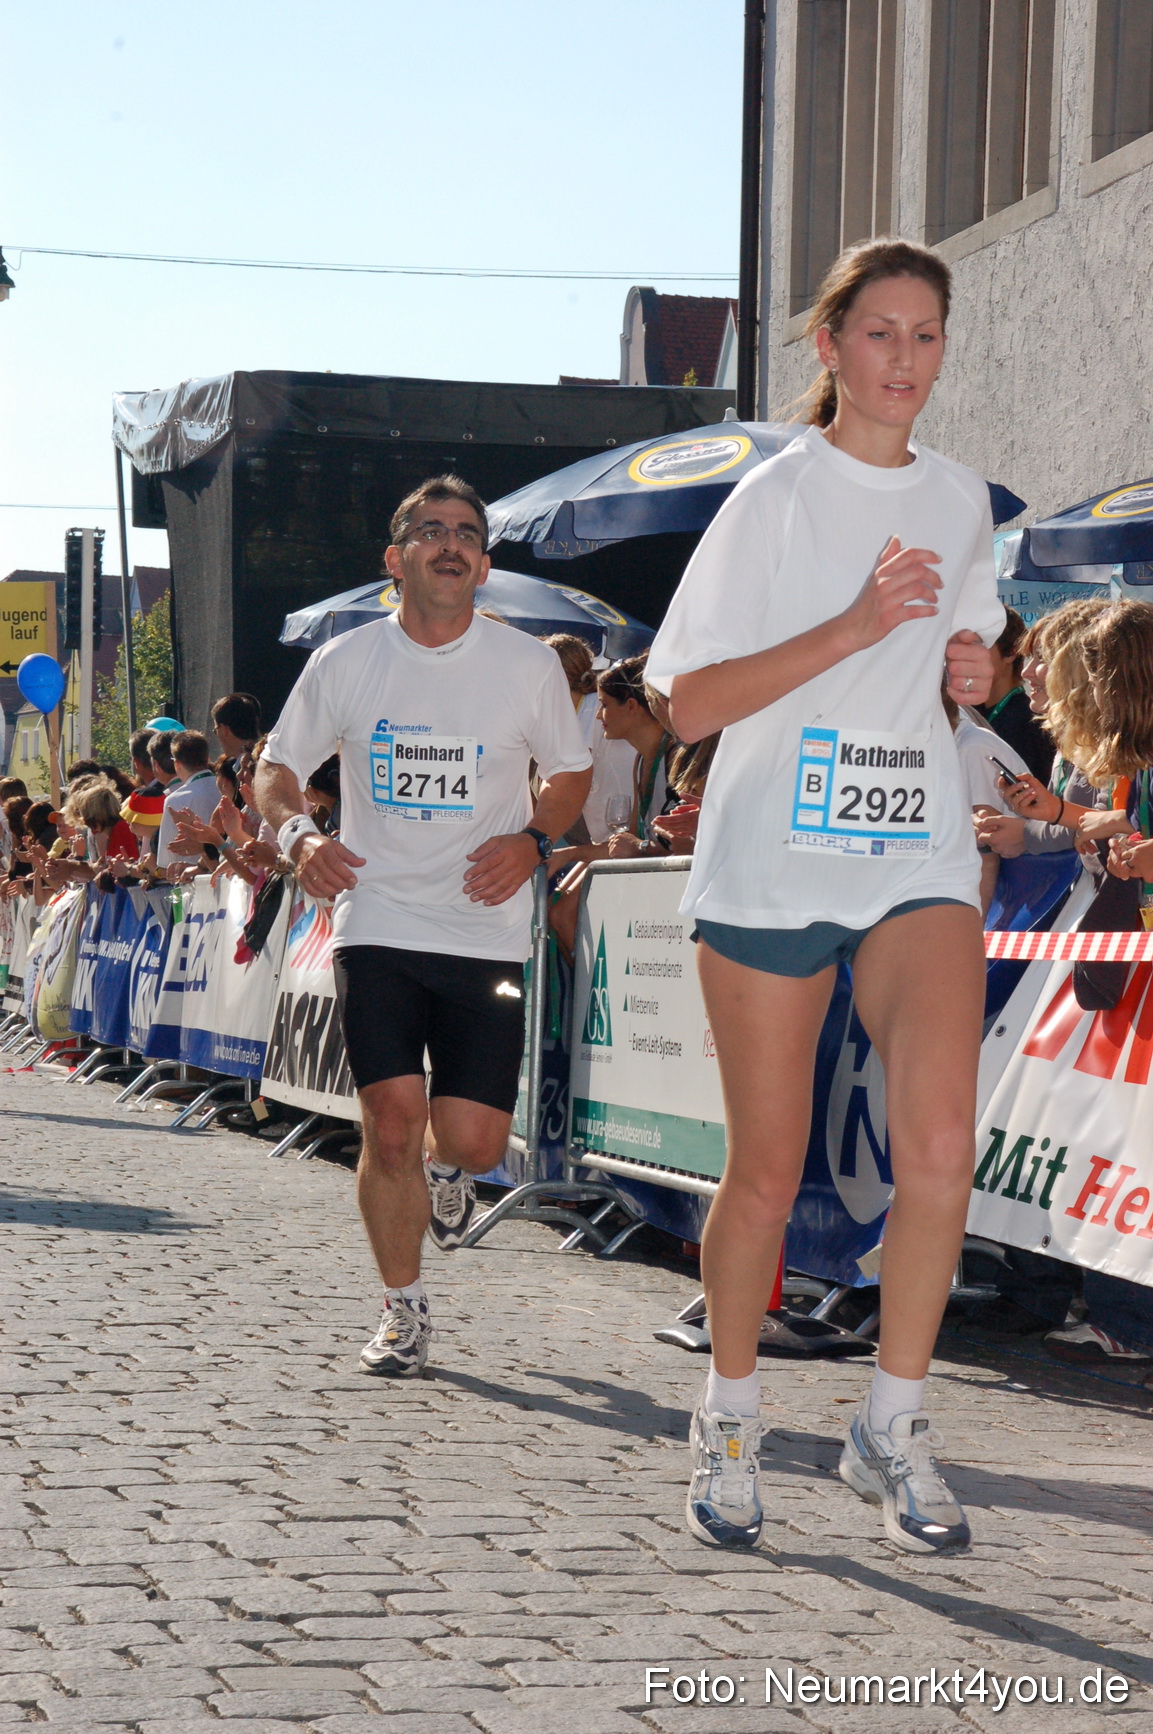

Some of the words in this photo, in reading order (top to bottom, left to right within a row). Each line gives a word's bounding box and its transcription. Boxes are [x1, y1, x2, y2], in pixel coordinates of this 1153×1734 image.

[0, 607, 47, 625] ugend
[10, 625, 39, 640] lauf
[389, 723, 432, 733] Neumarkter
[395, 744, 464, 762] Reinhard
[840, 742, 925, 768] Katharina
[376, 765, 386, 778] C
[396, 772, 469, 800] 2714
[806, 773, 822, 793] B
[836, 785, 926, 823] 2922
[433, 810, 473, 819] PFLEIDERER
[792, 832, 852, 849] BOCK
[885, 839, 930, 851] PFLEIDERER
[633, 920, 683, 944] Gebäudereinigung
[631, 957, 682, 978] Hausmeisterdienste
[629, 995, 659, 1015] Mietservice
[631, 1032, 682, 1060] Event-Leit-Systeme
[576, 1113, 662, 1149] www.jura-gebaeudeservice.de
[973, 1127, 1069, 1211] Mit
